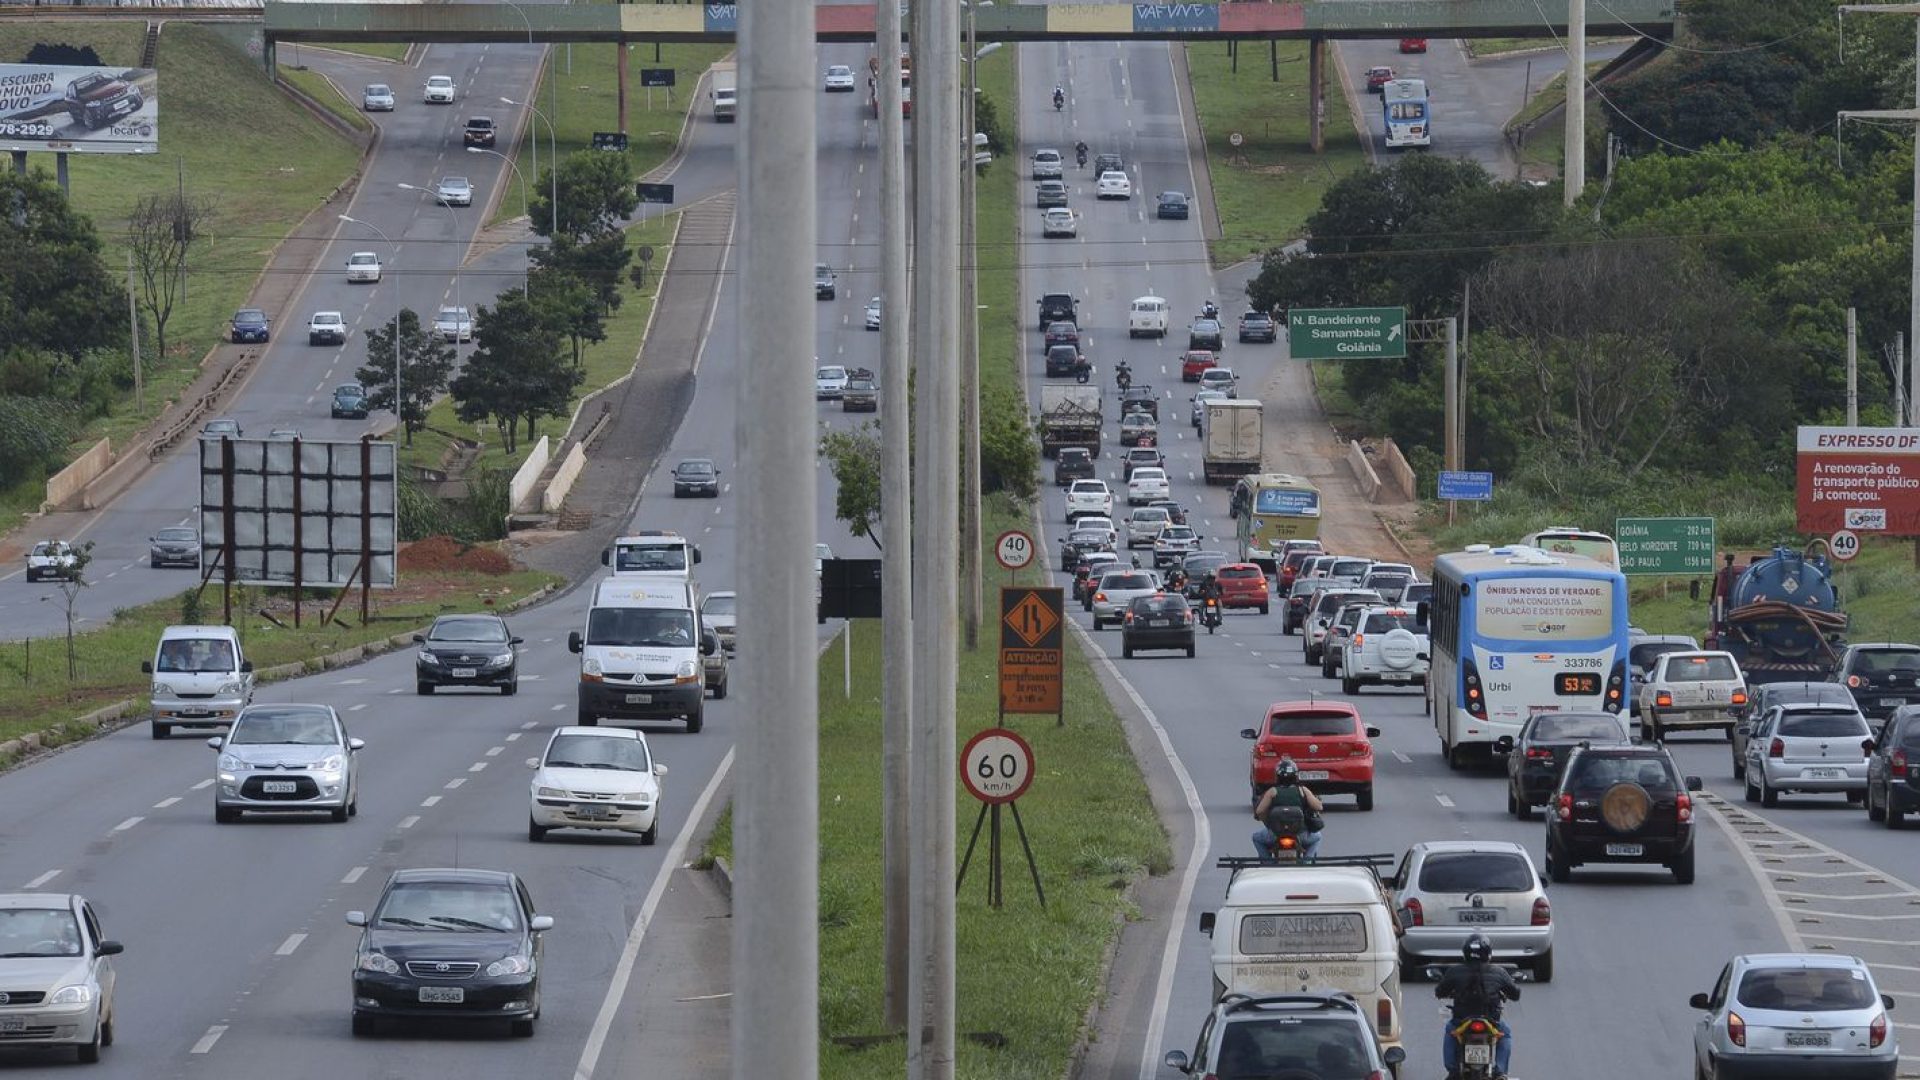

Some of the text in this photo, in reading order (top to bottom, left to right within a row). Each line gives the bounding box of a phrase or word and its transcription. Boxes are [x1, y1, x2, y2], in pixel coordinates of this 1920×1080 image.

[3, 83, 52, 97] MUNDO
[1292, 314, 1381, 325] N. Bandeirante
[1311, 327, 1381, 339] Samambaia
[1336, 341, 1382, 352] Goiânia
[1818, 434, 1918, 448] EXPRESSO DF
[1813, 462, 1901, 476] A renovação do
[1813, 475, 1919, 490] transporte público
[1812, 488, 1881, 502] já começou.
[1620, 526, 1649, 537] GOIÂNIA
[1701, 526, 1711, 535] km
[1005, 536, 1025, 551] 40
[1620, 541, 1638, 552] BELO
[1640, 540, 1678, 552] HORIZONTE
[1701, 541, 1711, 550] km
[1834, 535, 1856, 549] 40
[1638, 557, 1661, 568] PAULO
[1701, 556, 1711, 566] km
[1486, 584, 1517, 595] ÔNIBUS
[1519, 586, 1547, 595] NOVOS
[1549, 587, 1559, 595] DE
[1507, 598, 1582, 607] UMA CONQUISTA DA
[1485, 606, 1532, 617] POPULAÇÃO
[1539, 607, 1563, 615] DESTE
[1006, 652, 1057, 664] ATENÇÃO
[1564, 658, 1603, 668] 333786
[1488, 682, 1512, 692] Urbi
[1565, 677, 1579, 691] 53
[978, 754, 1017, 778] 60
[983, 782, 1011, 791] km/h
